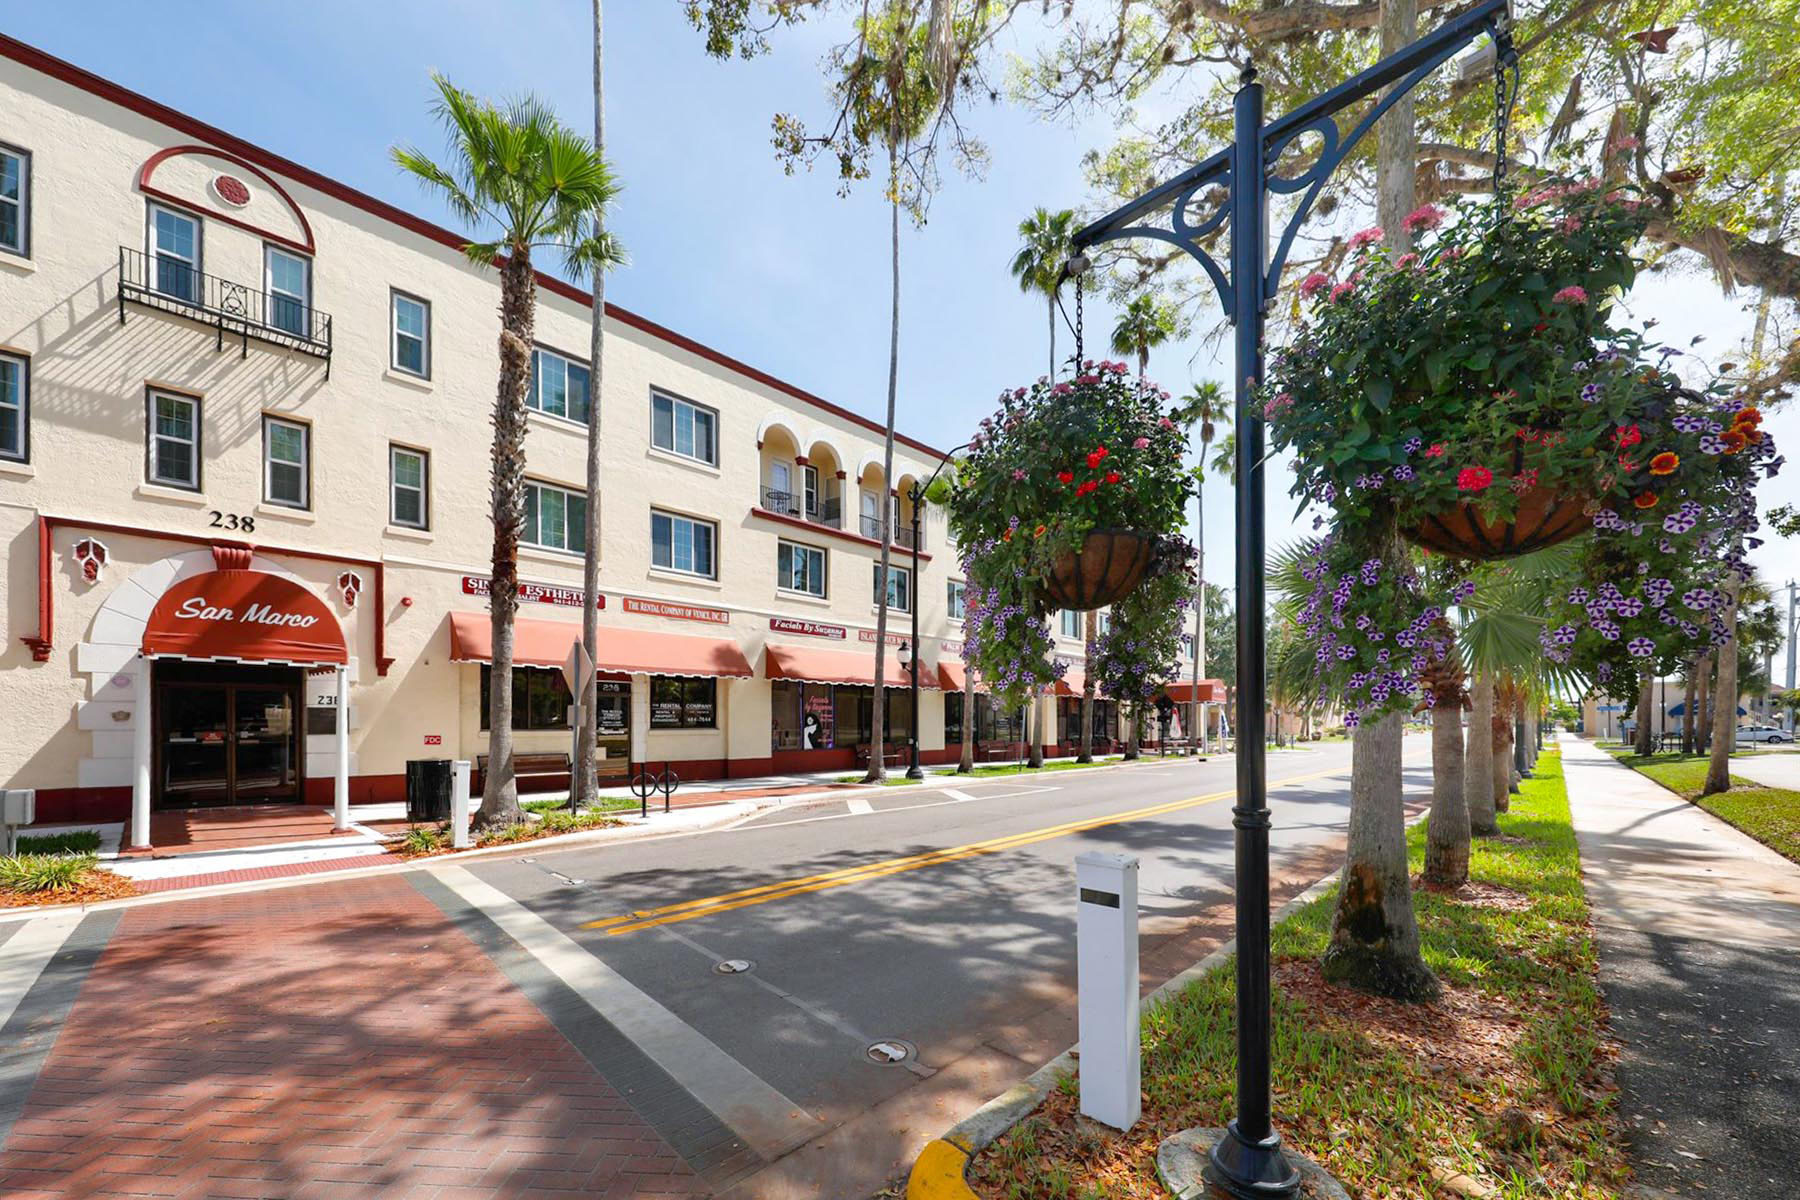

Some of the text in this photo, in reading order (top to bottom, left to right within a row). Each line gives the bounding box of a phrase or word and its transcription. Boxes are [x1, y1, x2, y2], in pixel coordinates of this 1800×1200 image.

[208, 511, 255, 533] 238
[526, 585, 600, 603] ESTHETI
[175, 597, 319, 628] San Marco
[628, 600, 639, 610] THE
[775, 619, 802, 630] Facials
[803, 623, 814, 633] By
[424, 736, 441, 744] FDC
